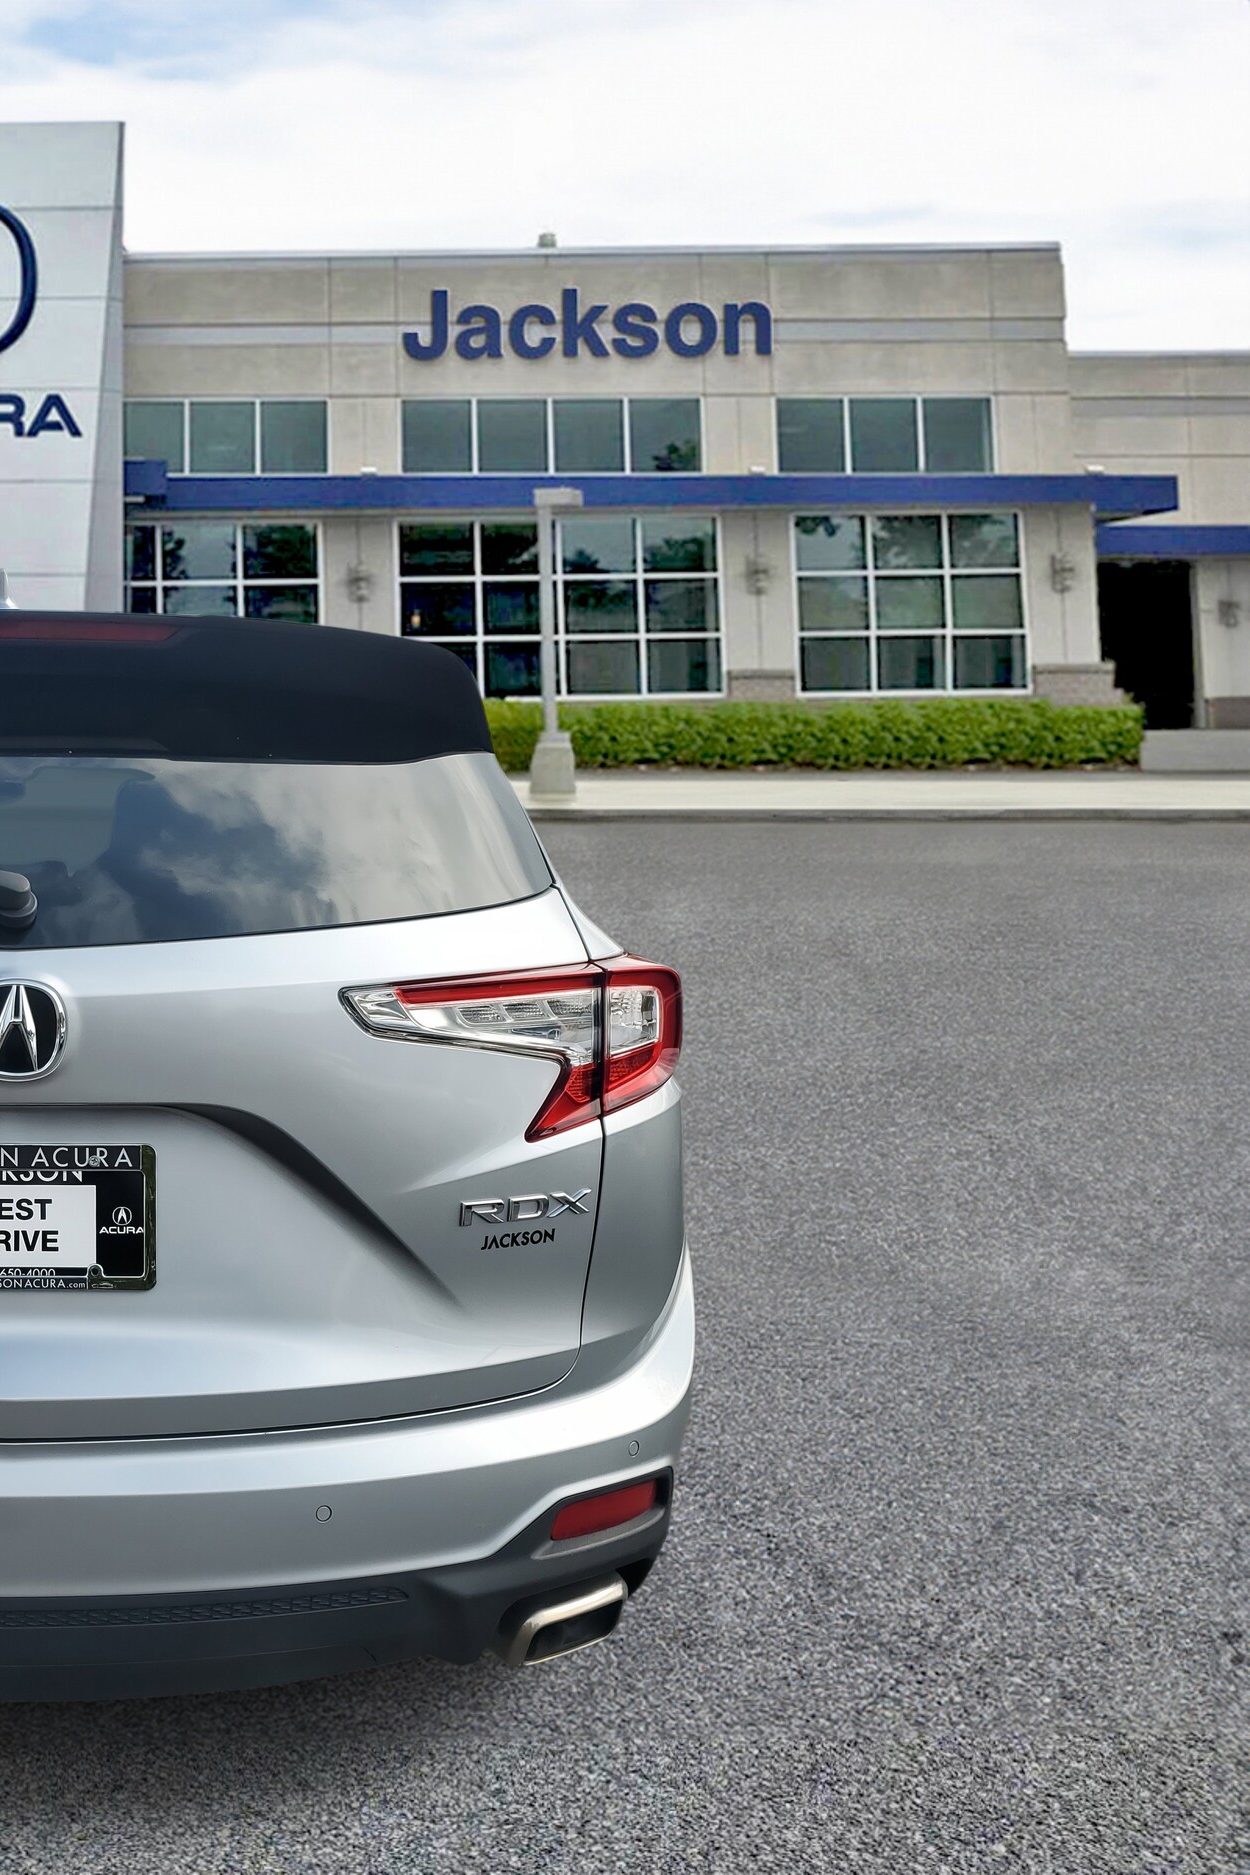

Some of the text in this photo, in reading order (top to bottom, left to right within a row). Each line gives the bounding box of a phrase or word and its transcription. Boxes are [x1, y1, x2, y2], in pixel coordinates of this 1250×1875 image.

[402, 287, 772, 361] Jackson
[31, 1147, 133, 1168] ACURA
[459, 1187, 592, 1227] RDX
[98, 1226, 145, 1235] ACURA
[480, 1228, 556, 1251] JACKSON
